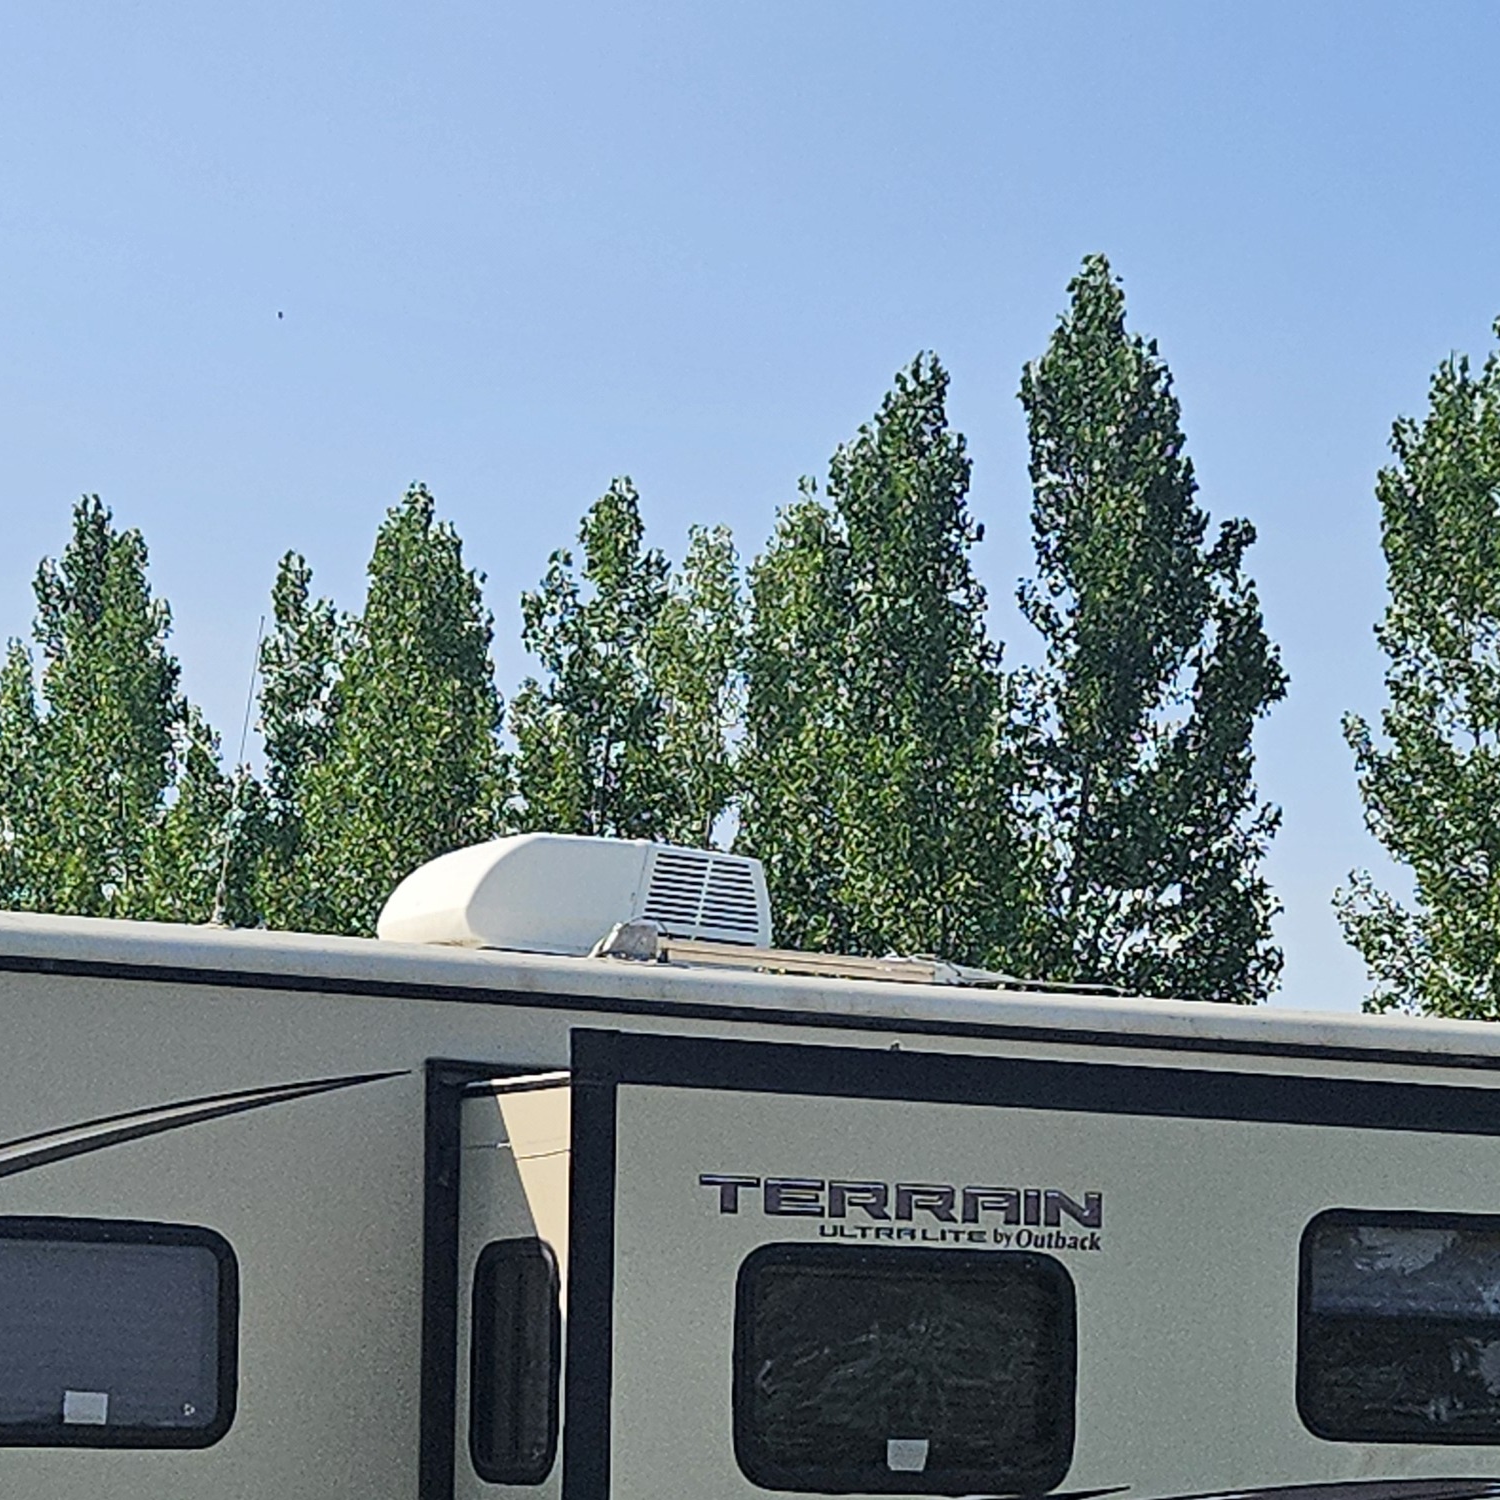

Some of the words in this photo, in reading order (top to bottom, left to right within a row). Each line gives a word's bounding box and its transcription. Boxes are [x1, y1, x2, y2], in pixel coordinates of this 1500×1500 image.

[699, 1174, 1102, 1228] TERRAIN
[992, 1228, 1012, 1249] by
[1015, 1229, 1101, 1251] Outback
